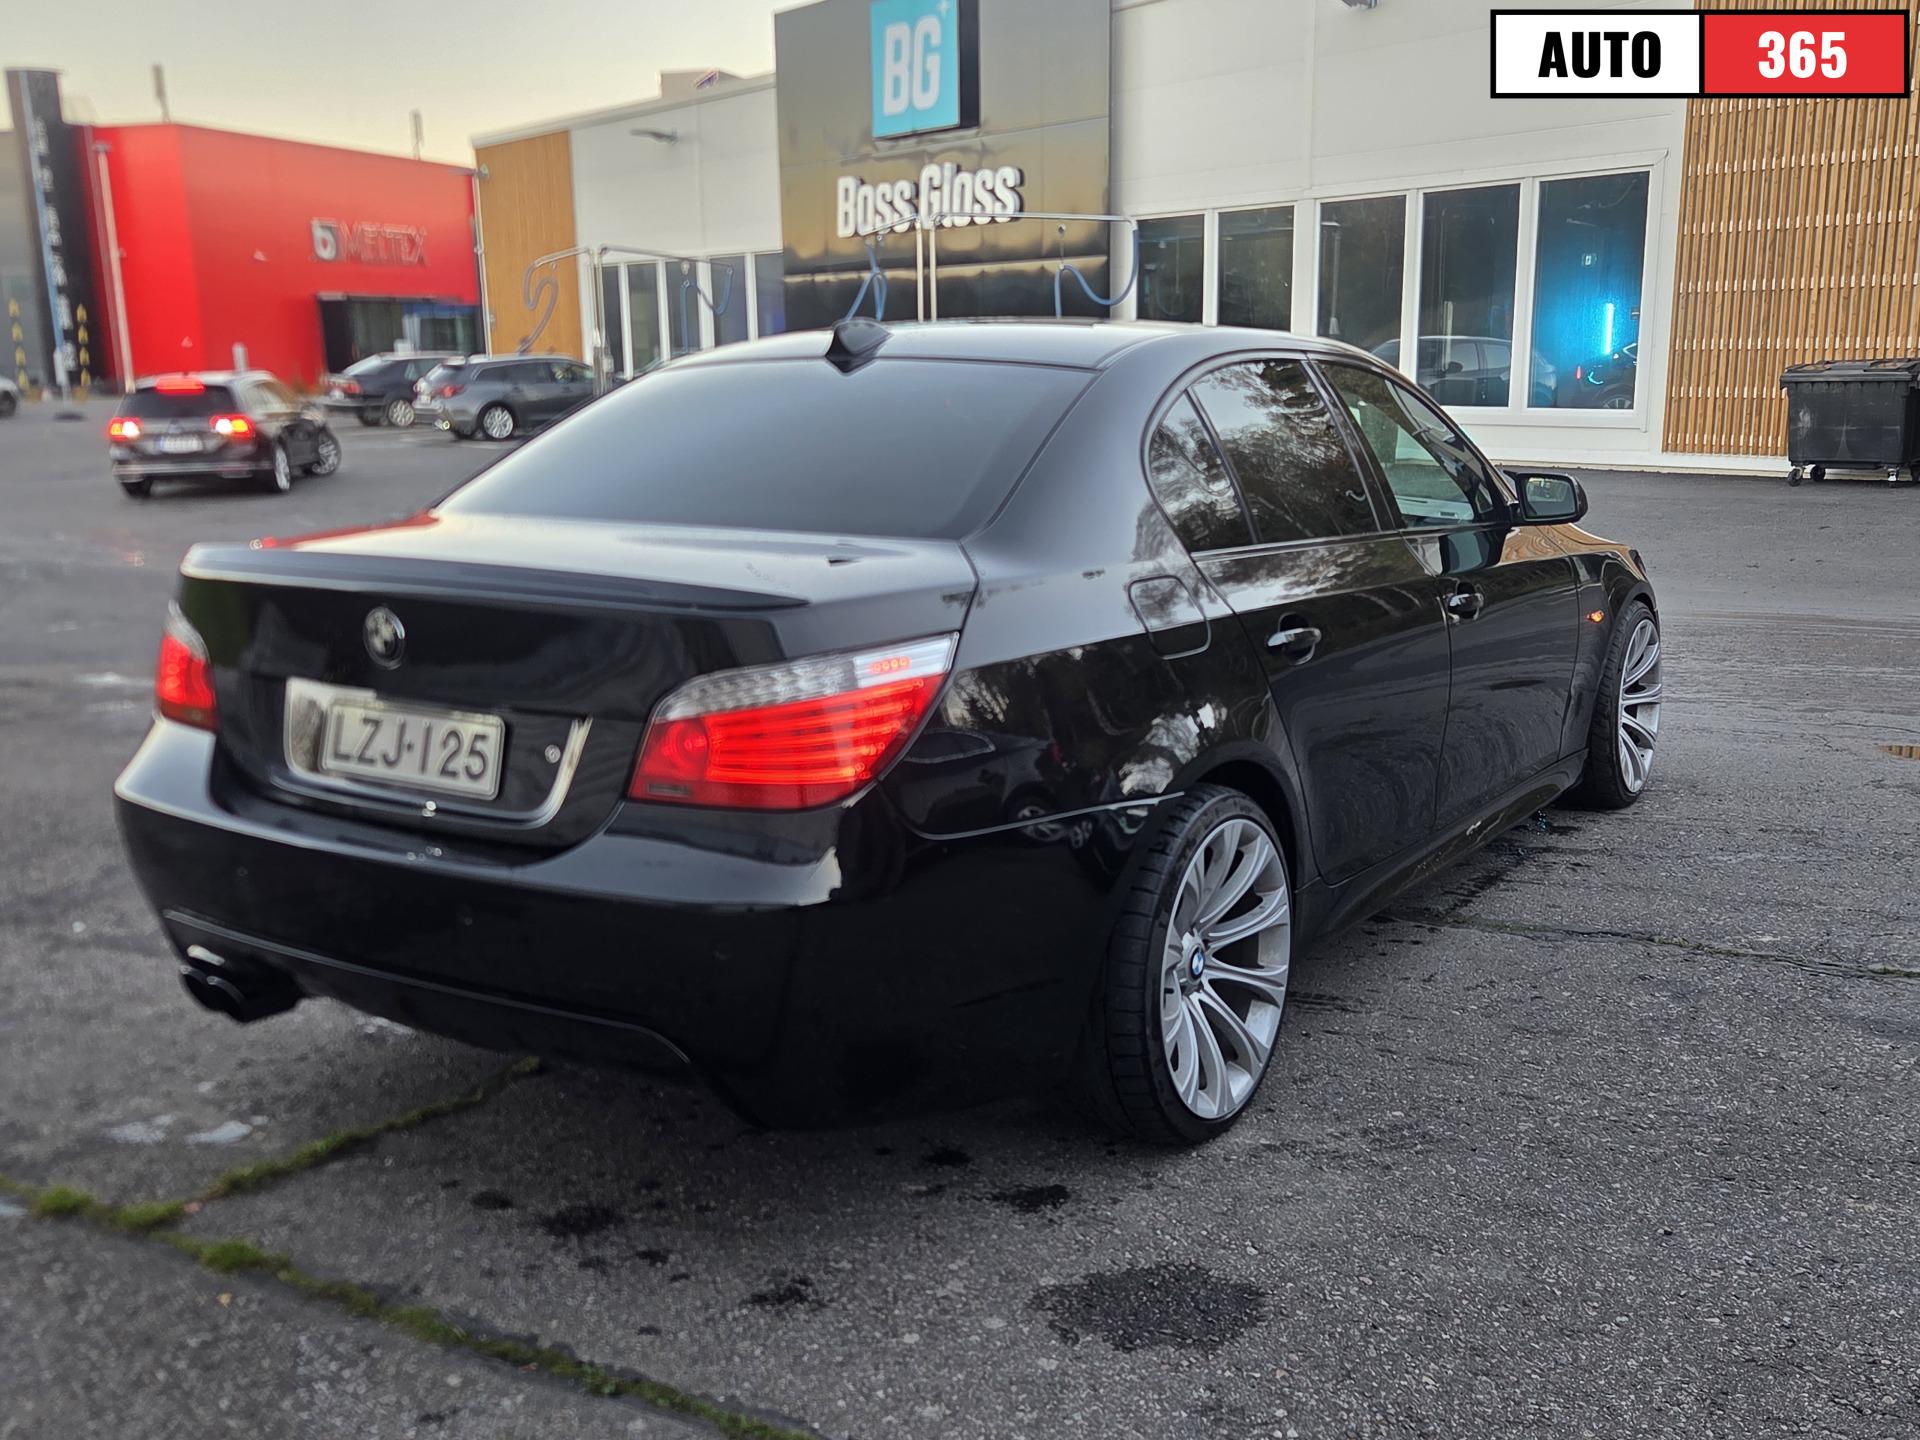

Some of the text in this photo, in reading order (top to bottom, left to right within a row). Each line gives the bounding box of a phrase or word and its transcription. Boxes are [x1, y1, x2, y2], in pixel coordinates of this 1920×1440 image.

[884, 16, 941, 117] BG
[837, 162, 1020, 238] Boss Gloss
